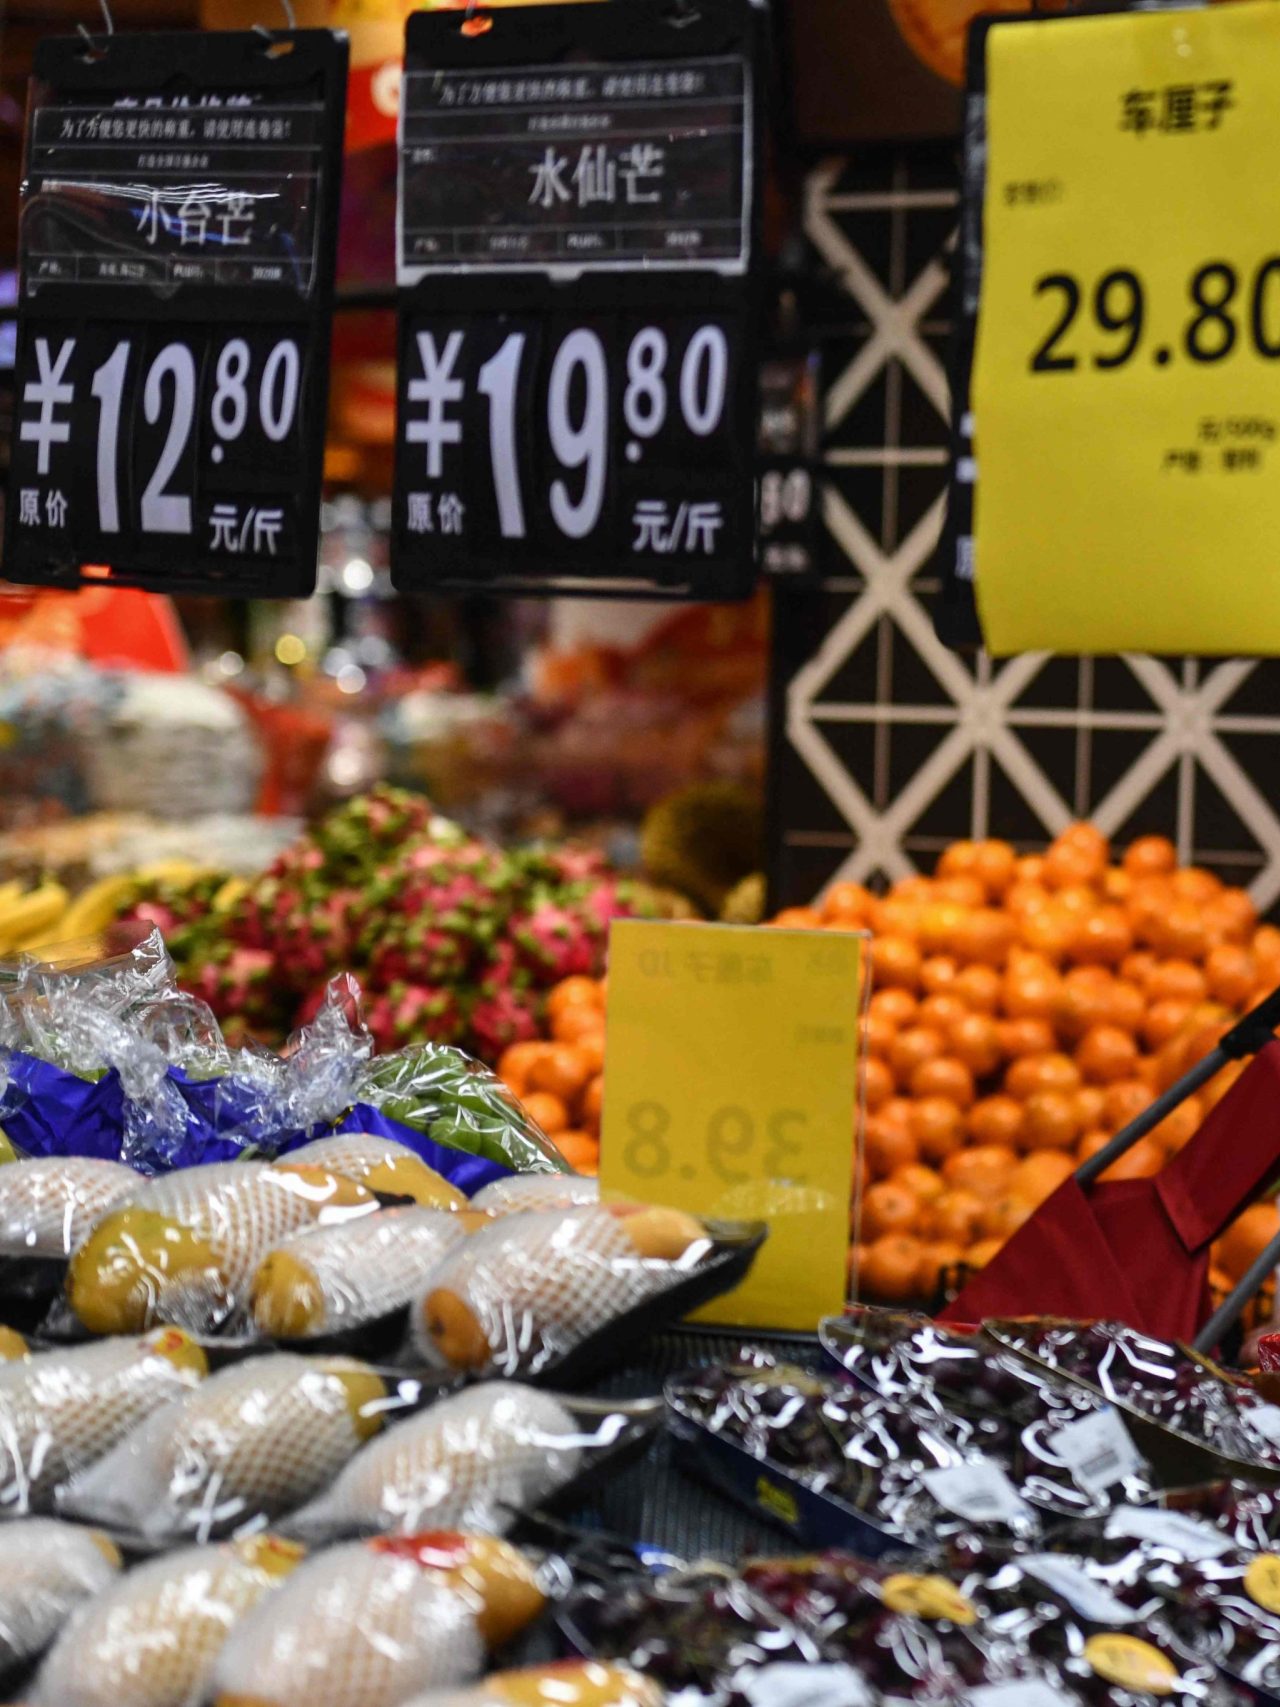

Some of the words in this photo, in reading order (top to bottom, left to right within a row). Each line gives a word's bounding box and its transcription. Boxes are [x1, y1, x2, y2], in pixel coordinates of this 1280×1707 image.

[1120, 79, 1234, 136] 车厘子
[528, 142, 666, 208] 水仙芒
[18, 488, 69, 528] 原价
[208, 503, 284, 556] 元/斤
[406, 492, 465, 535] 原价
[631, 500, 725, 555] 元/斤
